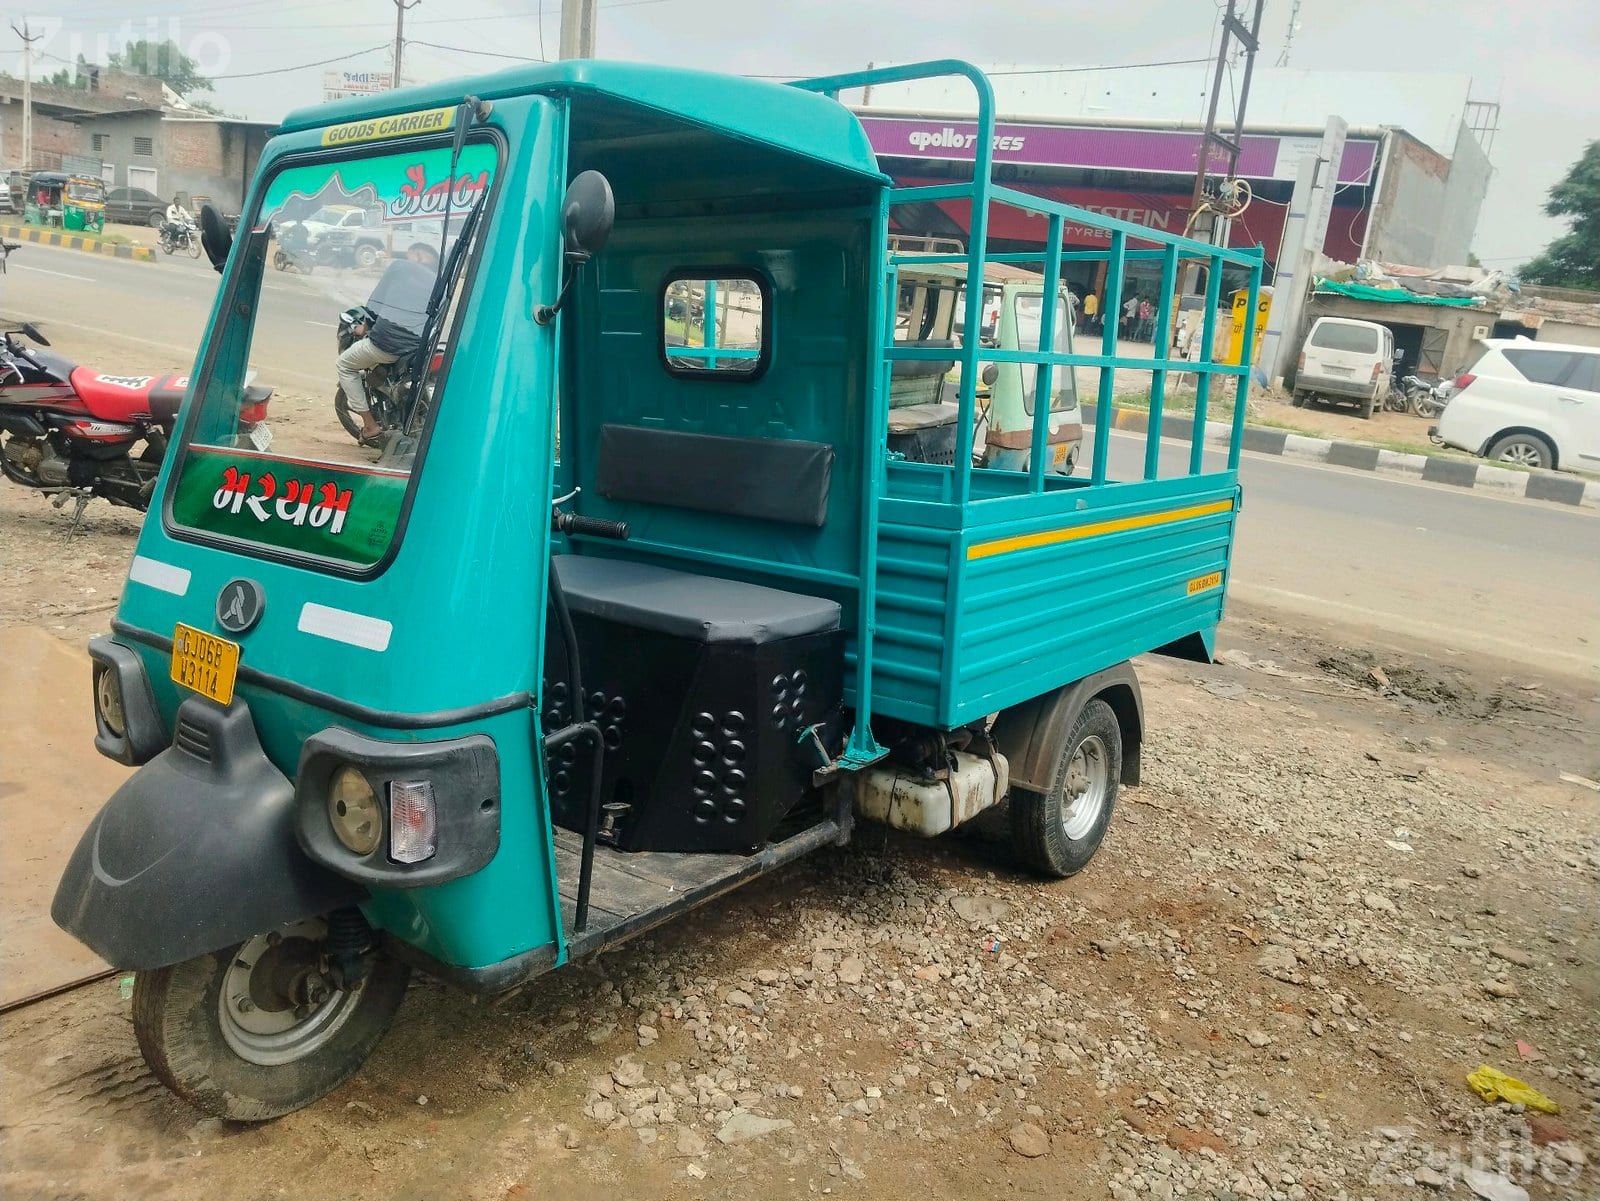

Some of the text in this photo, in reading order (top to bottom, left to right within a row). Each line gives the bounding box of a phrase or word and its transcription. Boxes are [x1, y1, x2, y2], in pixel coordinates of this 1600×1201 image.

[328, 112, 445, 142] GOODS CARRIER
[212, 465, 353, 535] મરયમ
[183, 630, 223, 669] GJ06B
